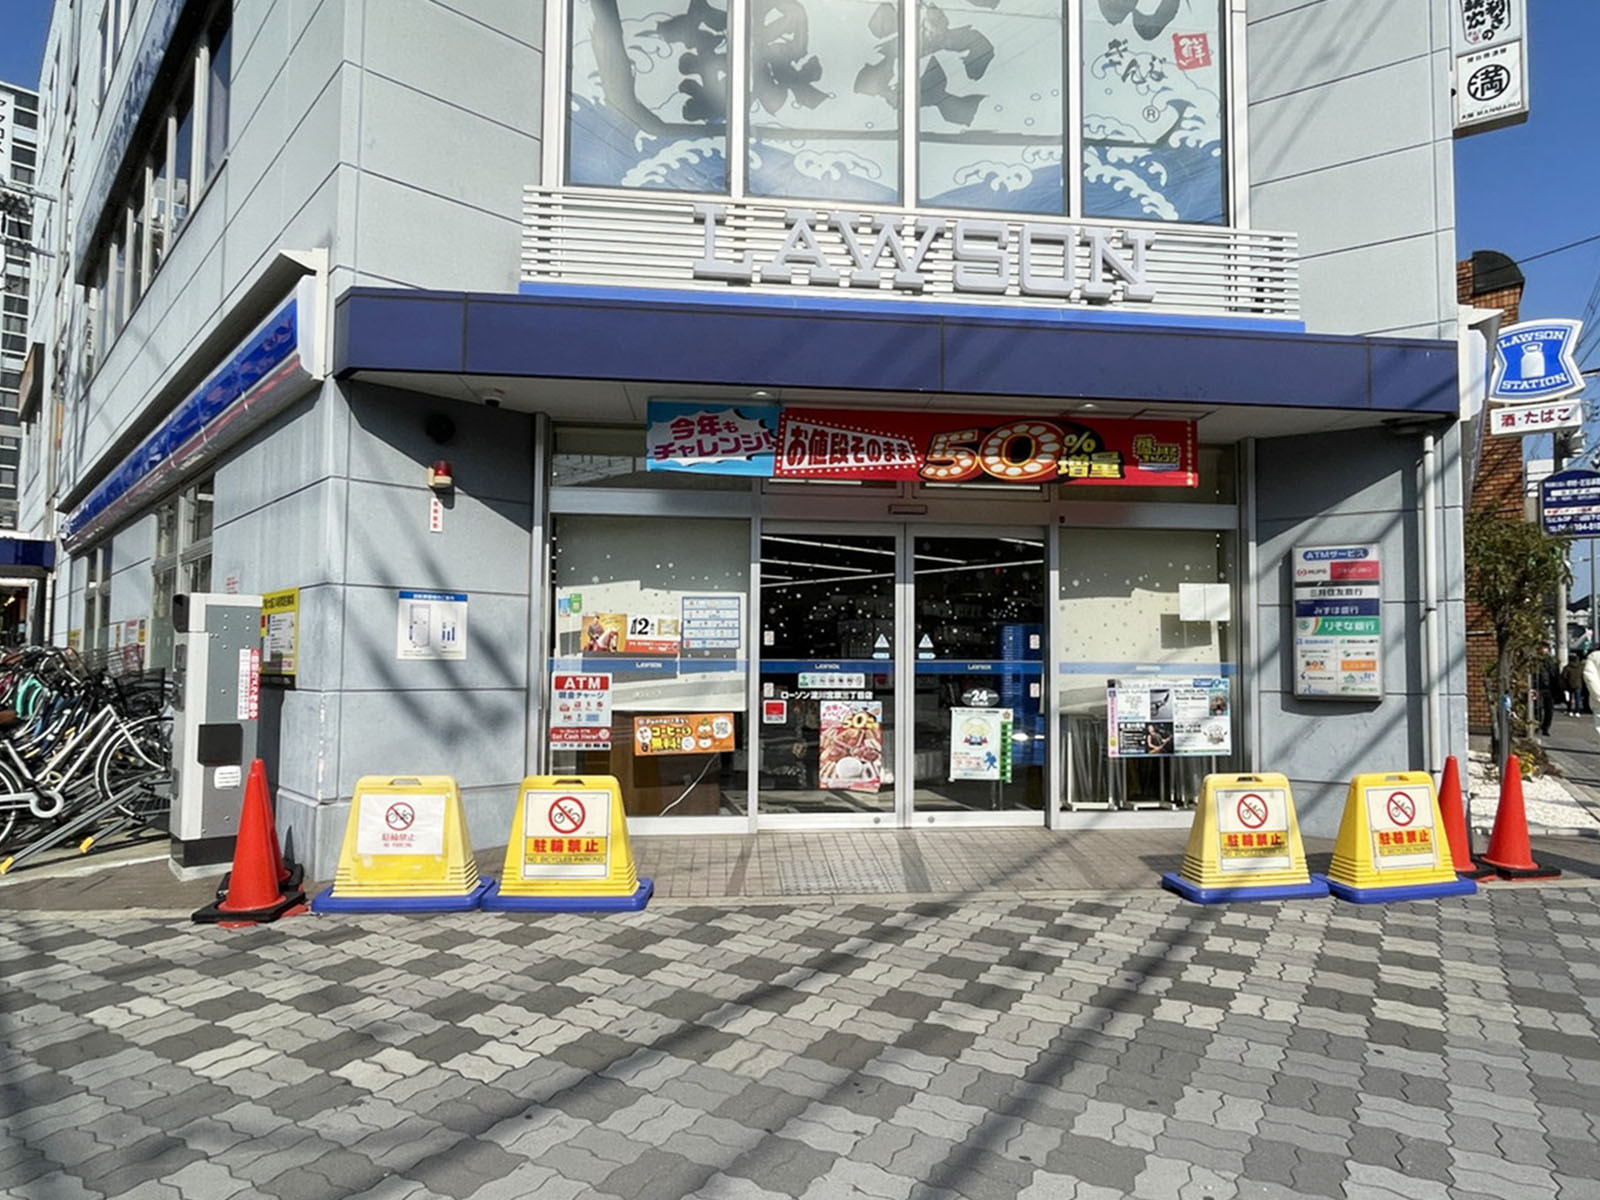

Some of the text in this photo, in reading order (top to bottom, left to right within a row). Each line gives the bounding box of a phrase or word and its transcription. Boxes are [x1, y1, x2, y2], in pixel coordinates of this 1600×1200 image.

[1468, 65, 1508, 100] 満
[693, 204, 1156, 304] LAWSON
[1500, 330, 1565, 349] LAWSON
[1501, 373, 1567, 391] STATION
[1501, 408, 1571, 427] 酒・たばこ
[670, 415, 739, 440] 今年も
[654, 431, 773, 461] チャレンジ!
[787, 425, 911, 467] お値段そのまま
[1057, 451, 1123, 478] 増量
[1306, 549, 1366, 559] ATMサービス
[1324, 621, 1375, 632] りそな銀行
[563, 676, 601, 690] ATM
[971, 689, 988, 702] 24
[533, 838, 599, 853] 駐輪禁止
[1227, 833, 1283, 847] 駐輪禁止
[1379, 829, 1430, 846] 駐輪禁止
